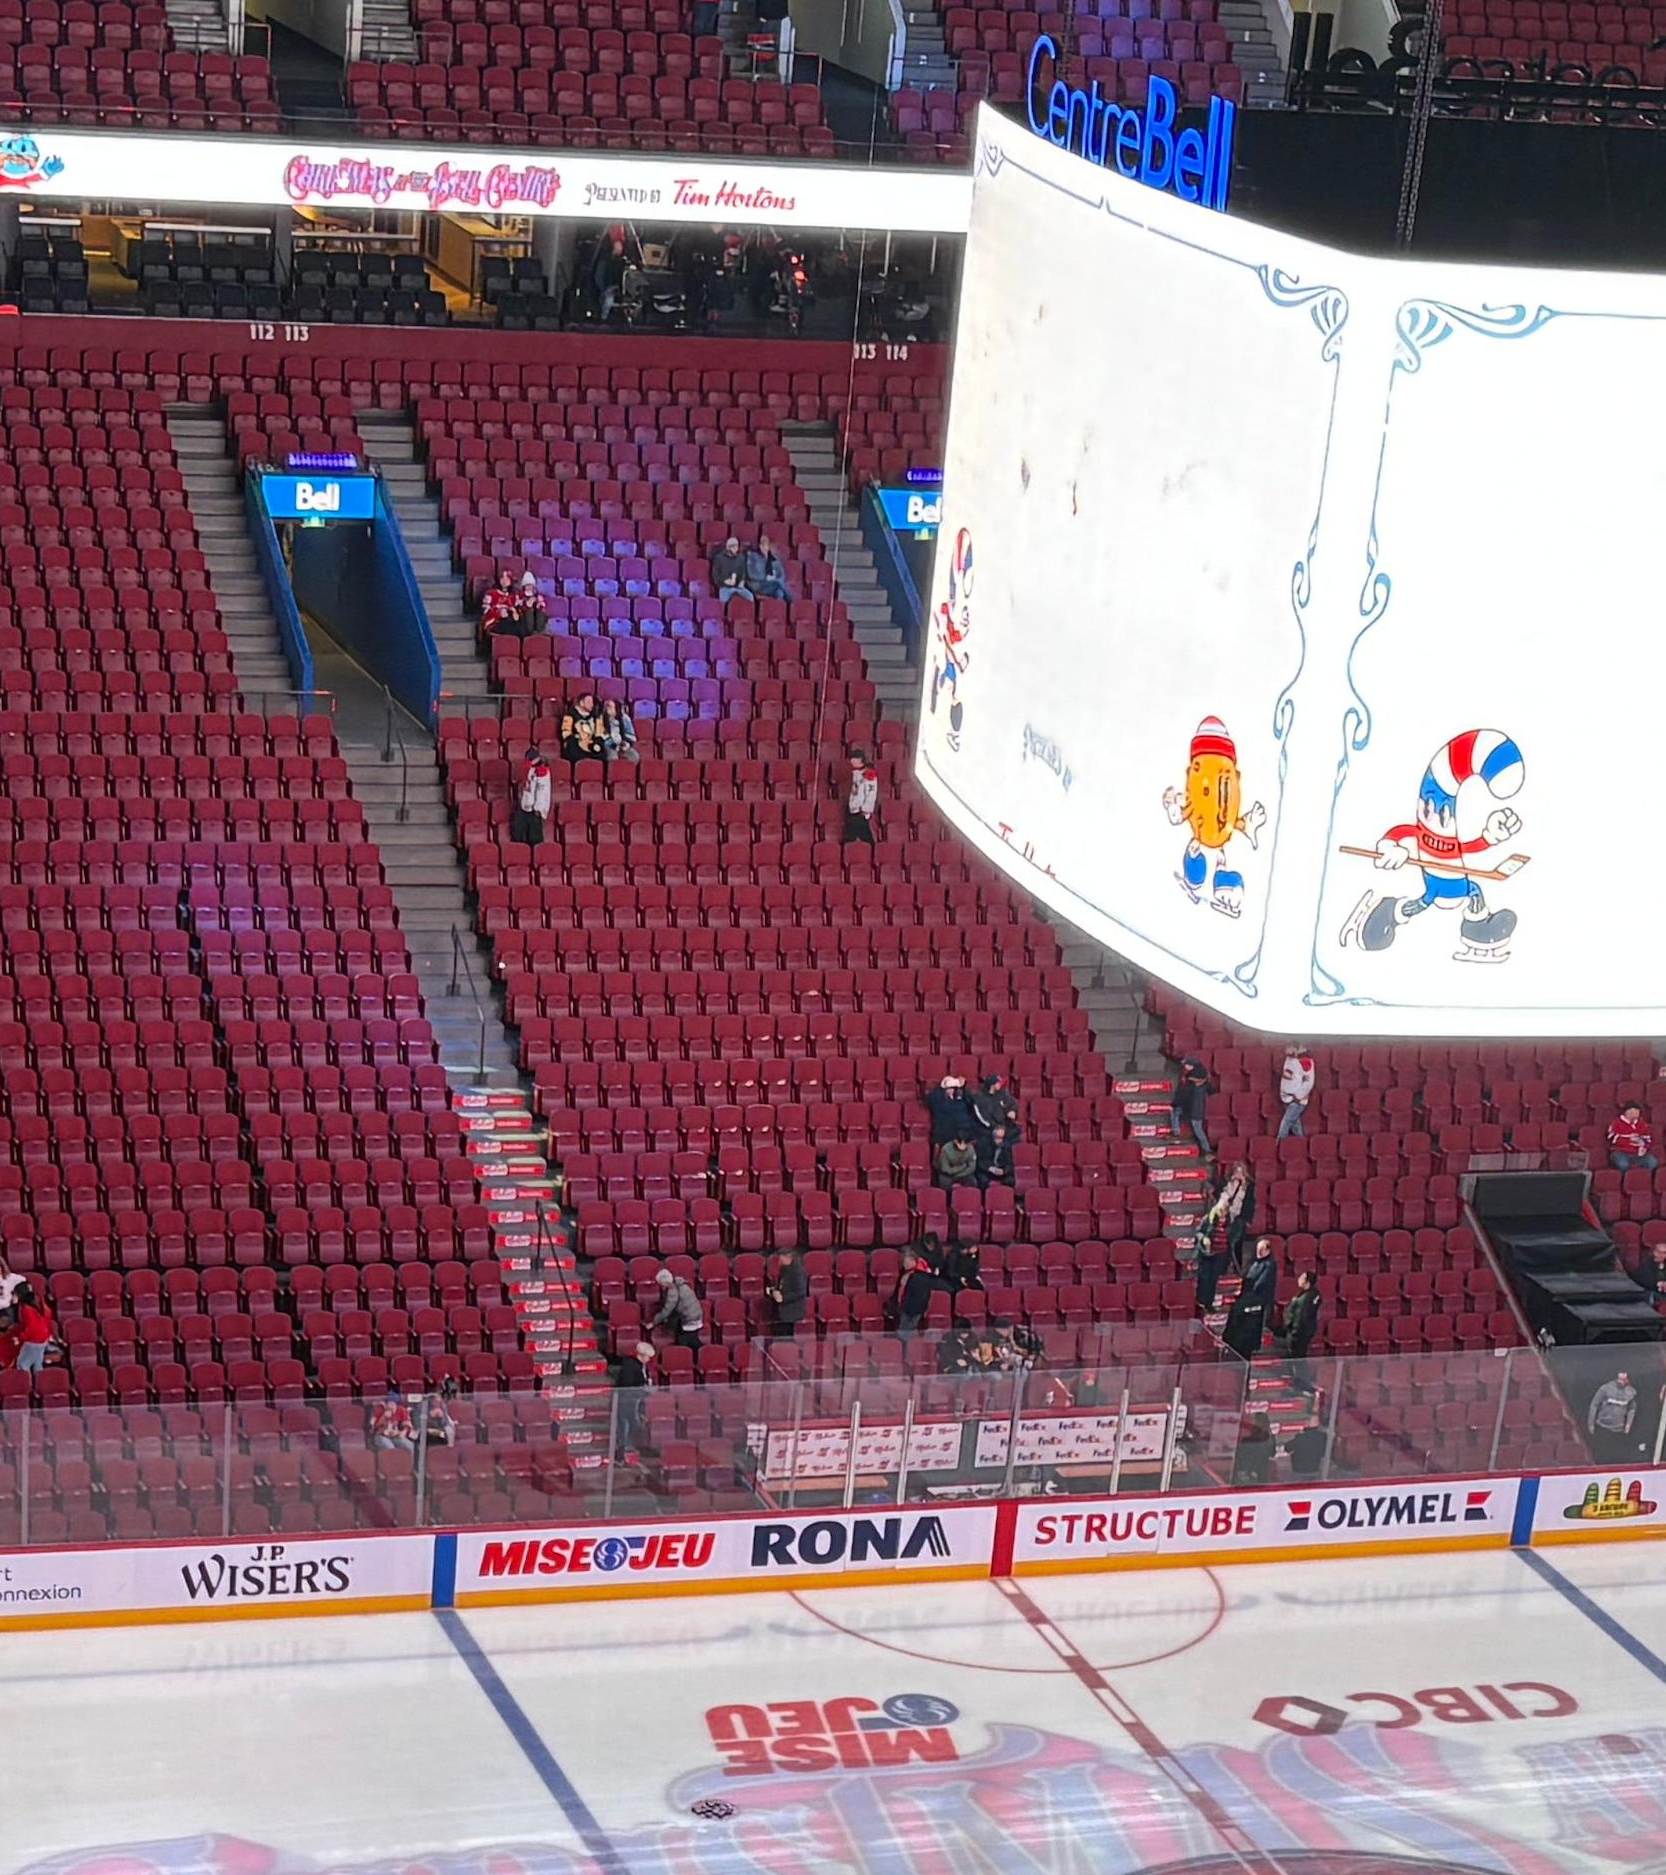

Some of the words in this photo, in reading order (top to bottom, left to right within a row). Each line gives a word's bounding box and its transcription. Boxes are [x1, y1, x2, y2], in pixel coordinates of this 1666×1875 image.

[1027, 34, 1234, 213] CentreBell
[673, 179, 710, 207] Tim
[715, 180, 796, 210] Hortons
[250, 324, 275, 340] 112
[285, 325, 310, 341] 113
[886, 344, 908, 361] 114
[295, 483, 340, 512] Bell
[906, 495, 942, 524] Be
[1034, 1505, 1257, 1547] STRUCTUBE
[1317, 1493, 1457, 1530] OLYMEL
[250, 1545, 286, 1563] J.P.
[750, 1515, 952, 1568] RONA
[181, 1555, 351, 1600] WISER'S
[705, 1697, 876, 1743] JEU
[1346, 1682, 1579, 1731] CIBC
[713, 1727, 961, 1777] MISE
